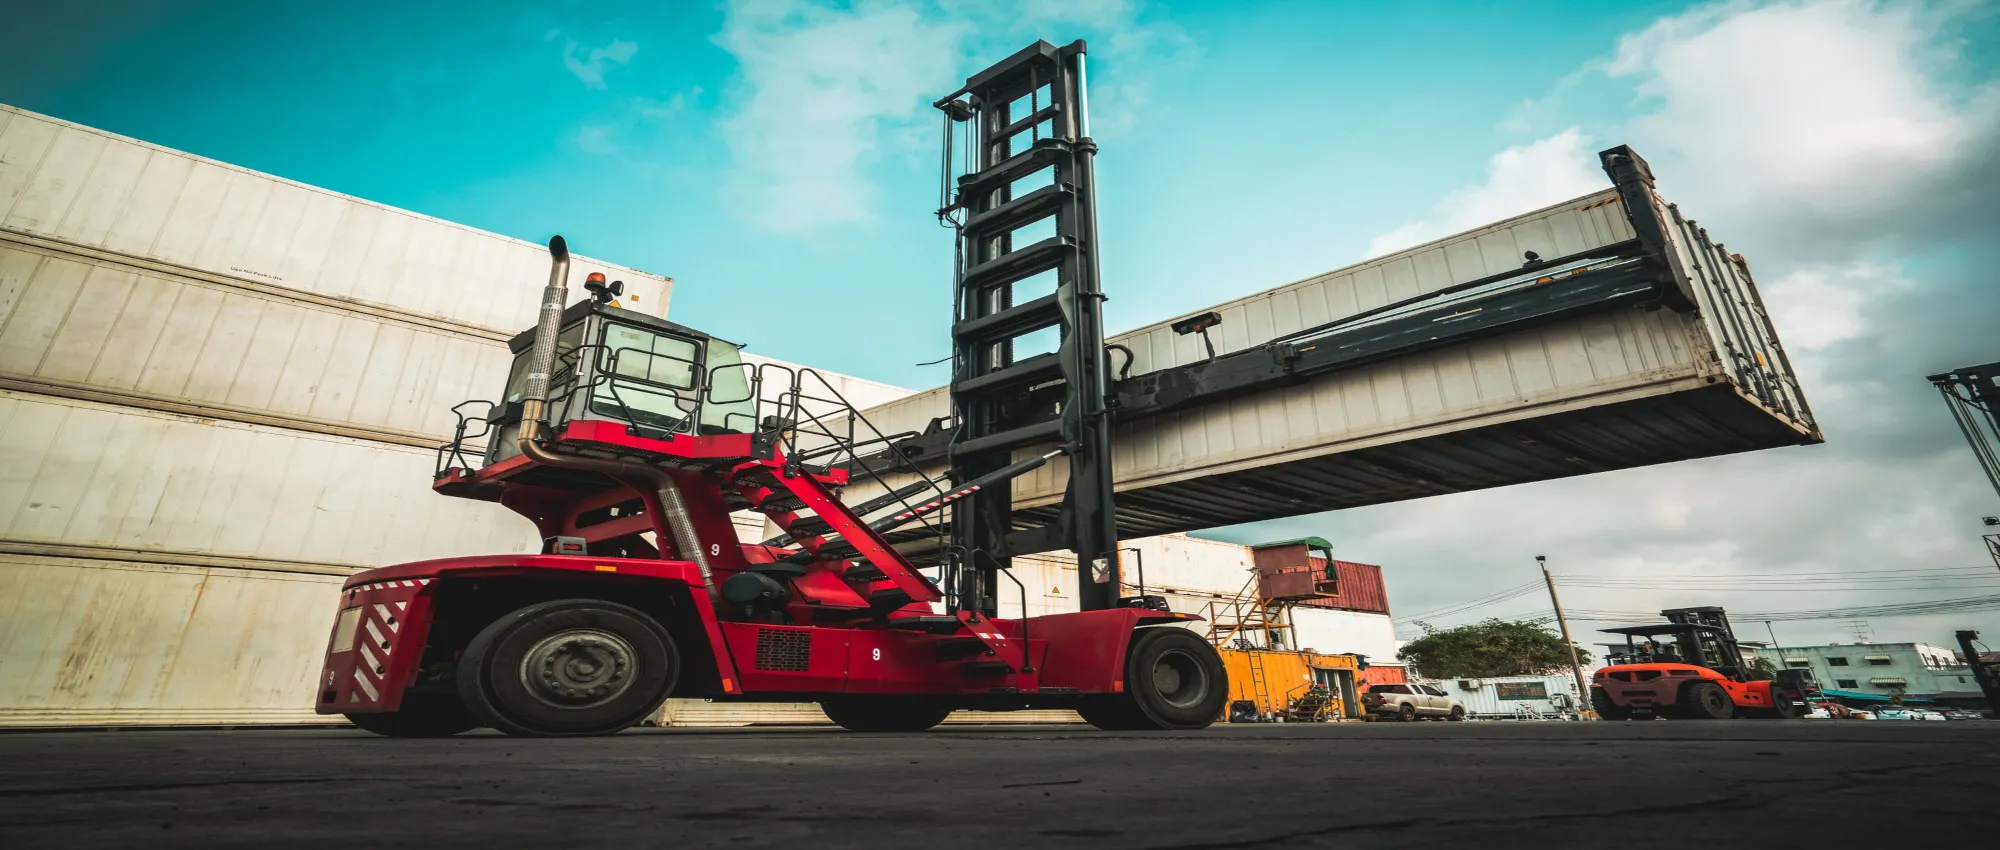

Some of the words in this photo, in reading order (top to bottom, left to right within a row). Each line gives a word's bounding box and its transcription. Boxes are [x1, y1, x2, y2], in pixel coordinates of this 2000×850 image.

[711, 543, 720, 556] 9
[872, 647, 880, 661] 9
[329, 670, 335, 685] 9
